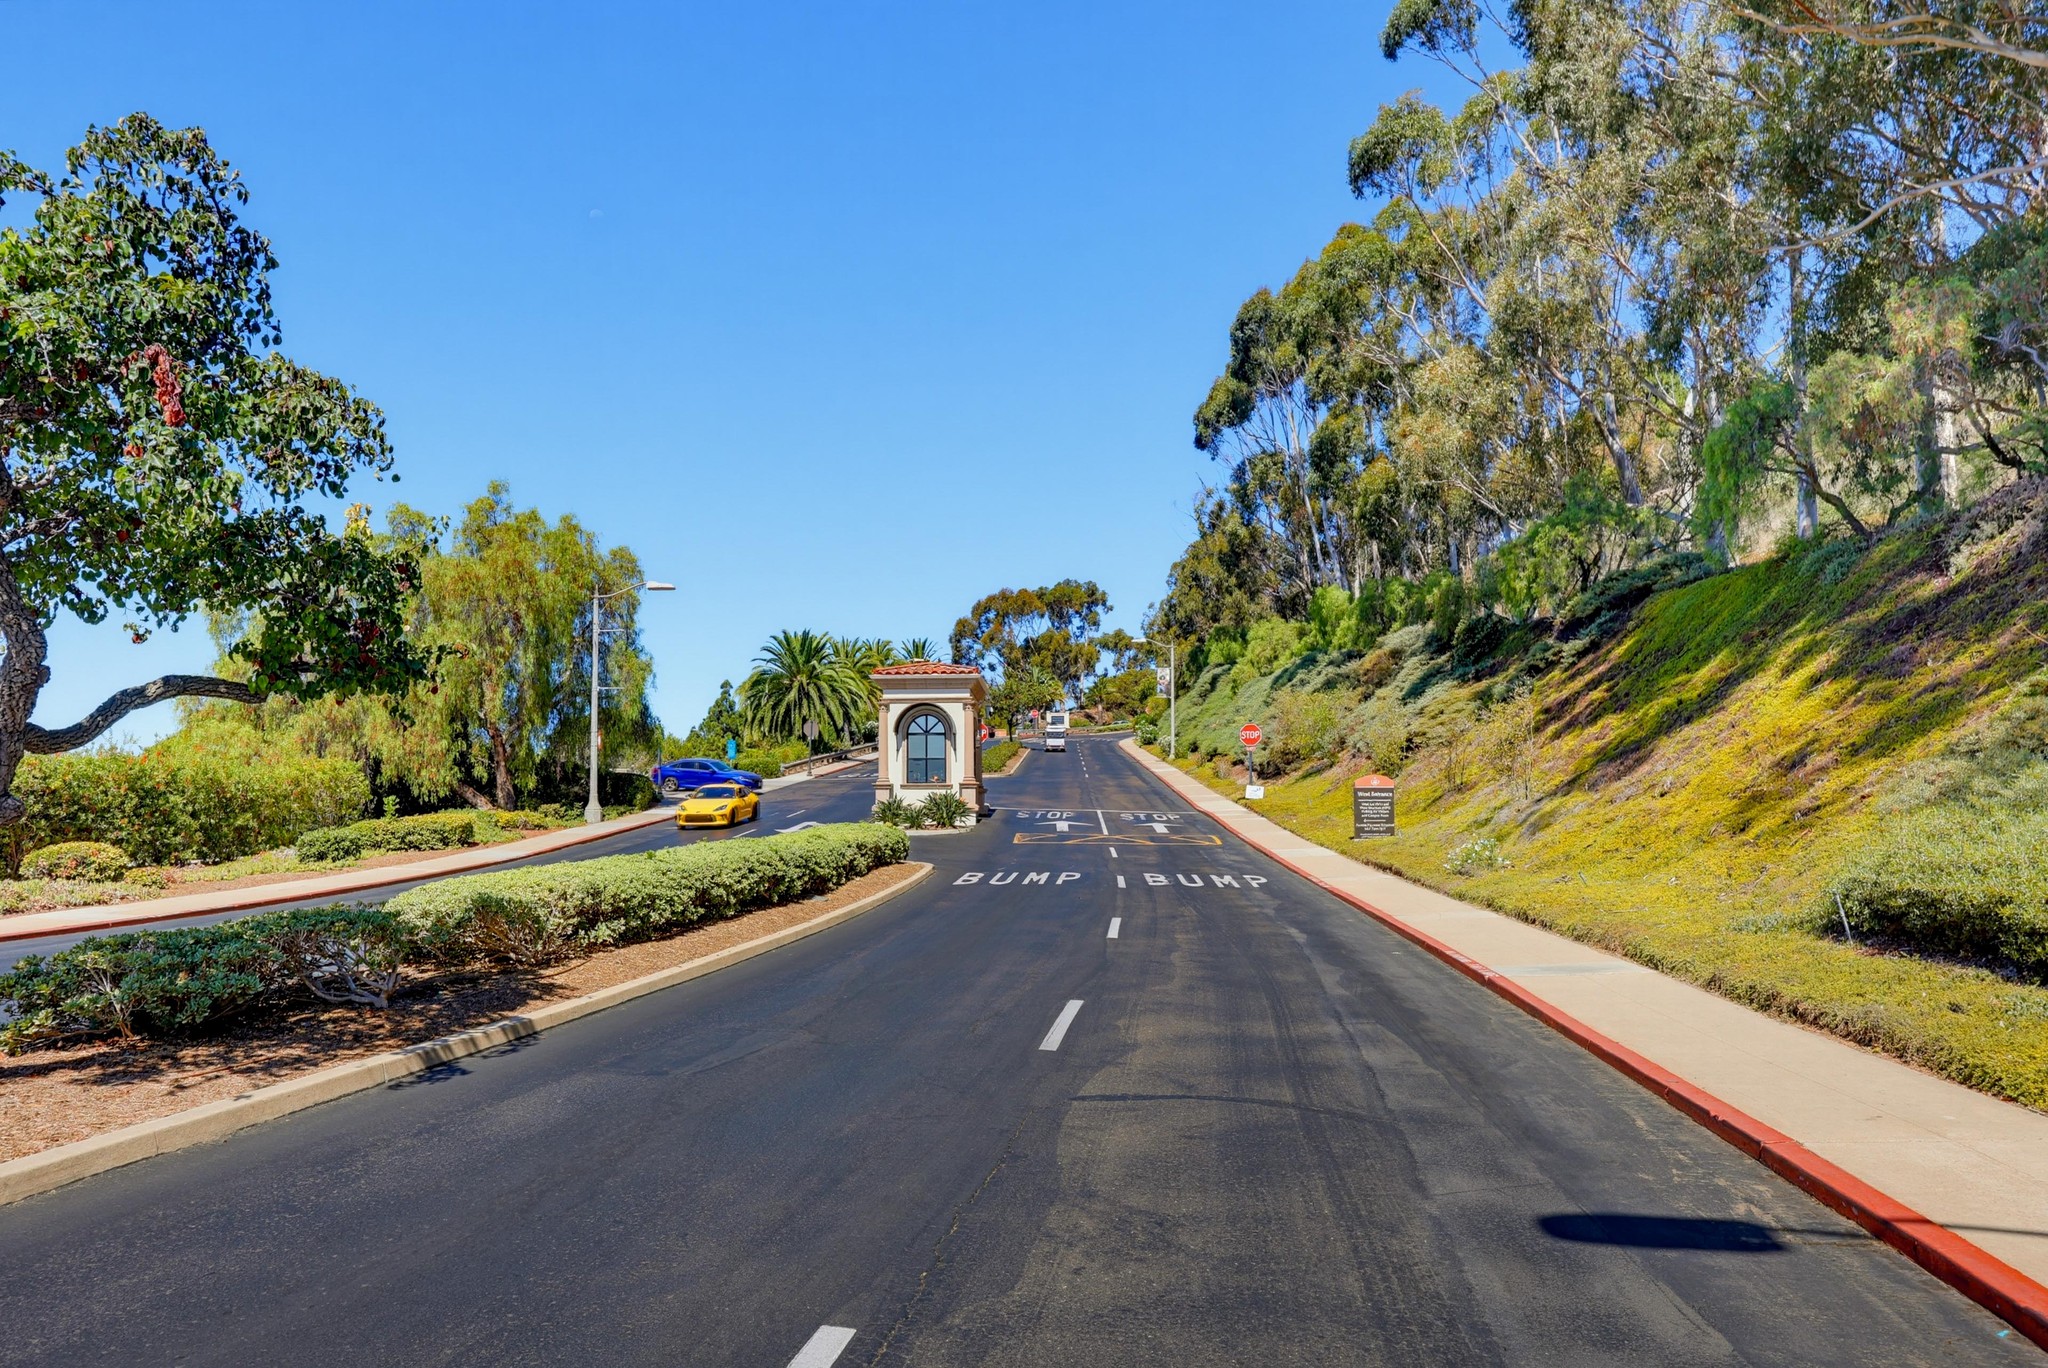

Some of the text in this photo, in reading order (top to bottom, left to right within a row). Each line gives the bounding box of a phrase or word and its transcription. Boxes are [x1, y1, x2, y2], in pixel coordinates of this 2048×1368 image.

[1241, 730, 1260, 740] STOP
[1016, 810, 1074, 819] STOP
[1119, 812, 1181, 821] STOP
[952, 871, 1082, 886] BUMP
[1145, 872, 1269, 889] BUMP
